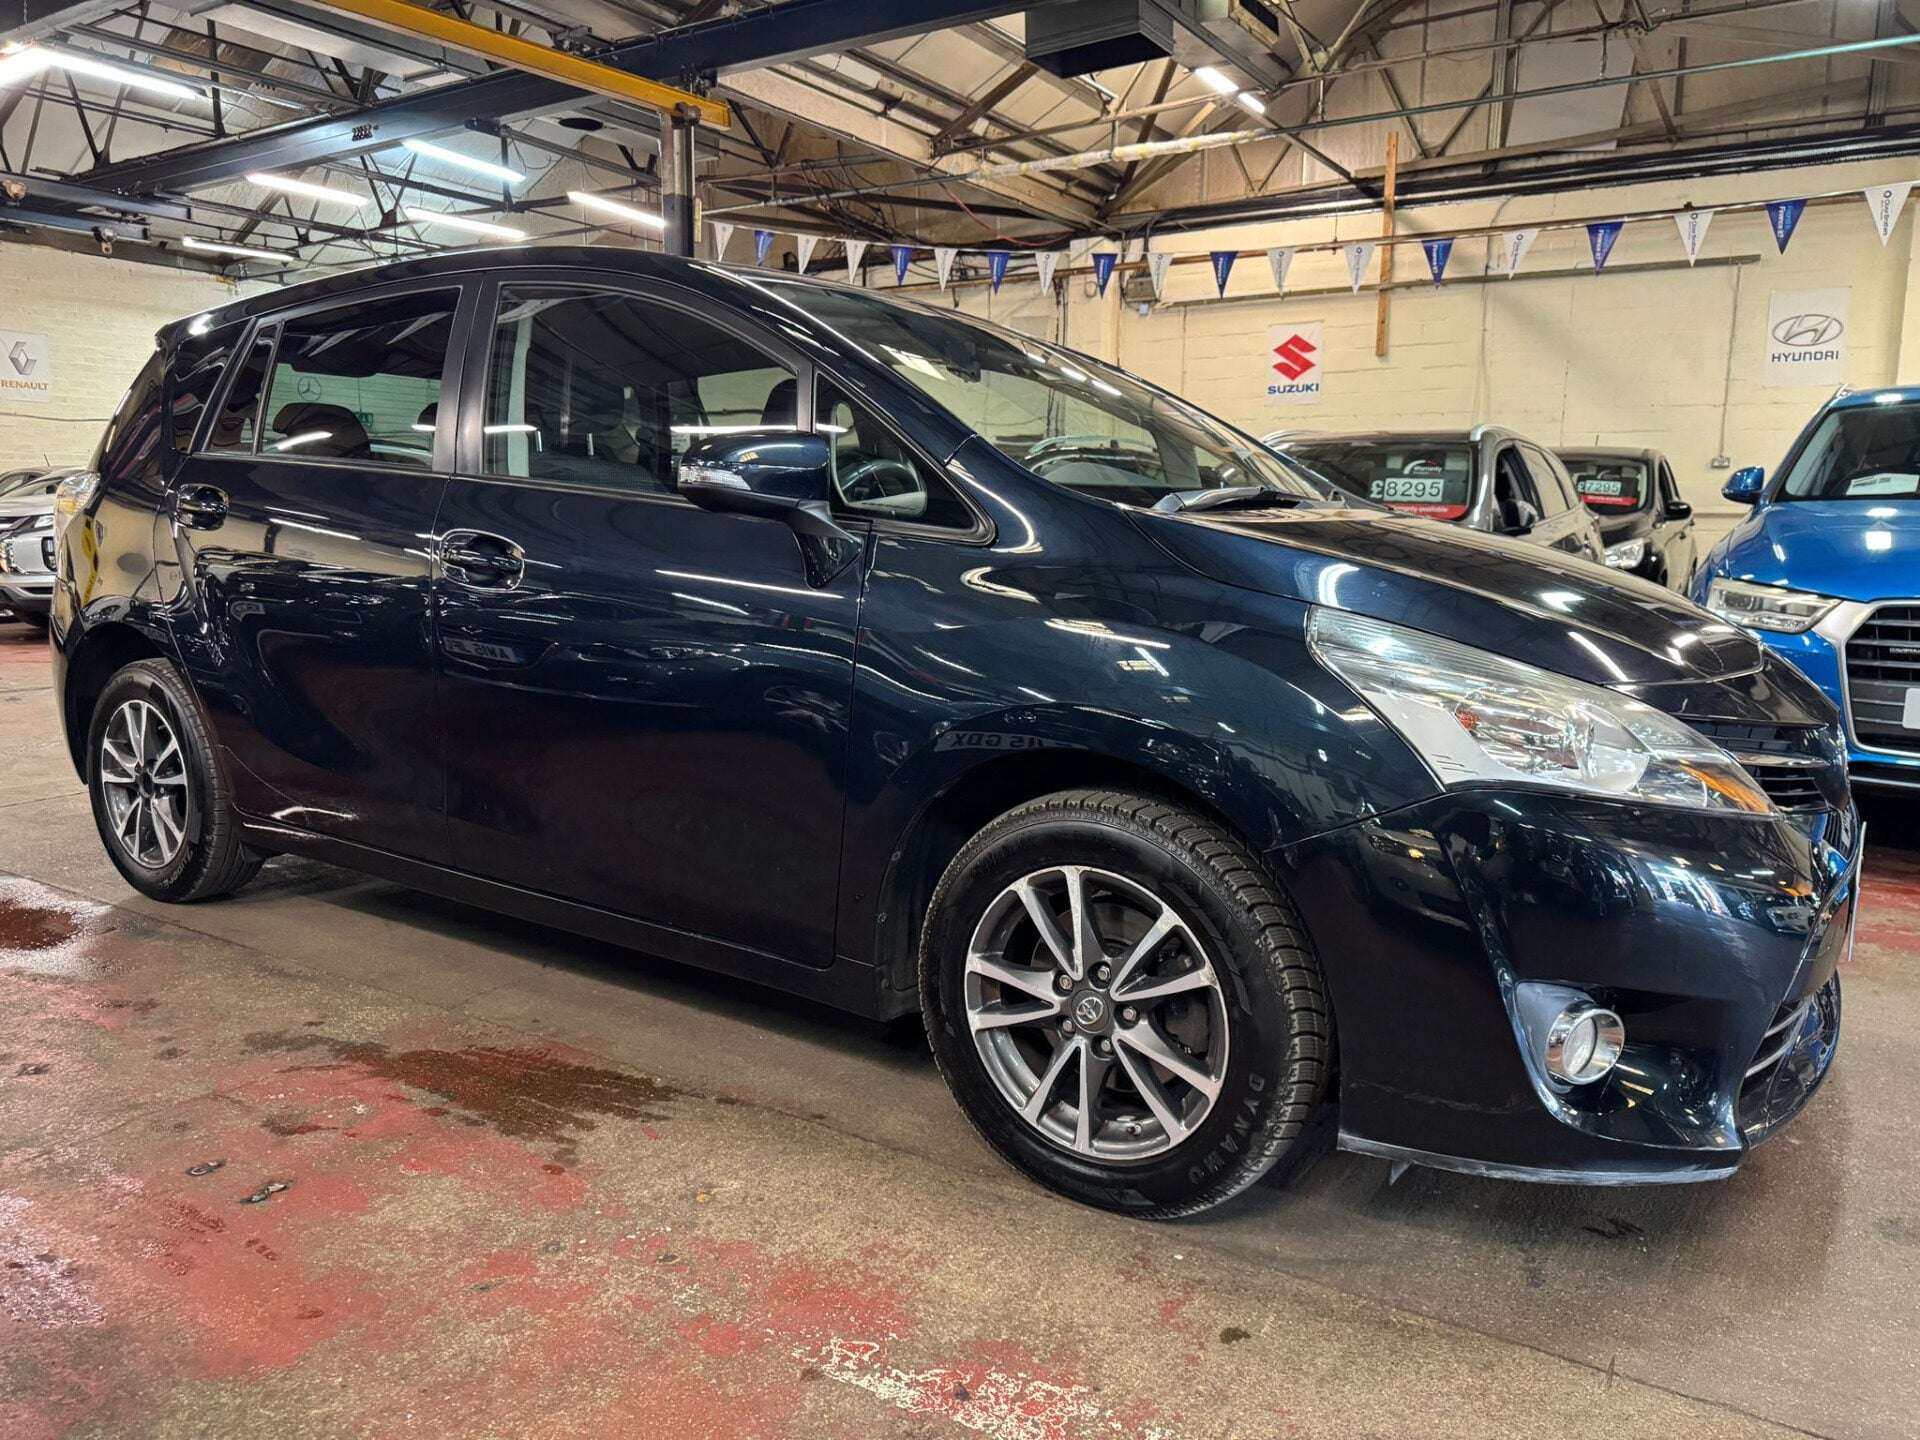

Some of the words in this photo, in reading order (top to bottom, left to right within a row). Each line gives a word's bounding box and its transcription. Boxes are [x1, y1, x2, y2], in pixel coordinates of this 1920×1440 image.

[1771, 350, 1839, 363] HYUNDAI
[0, 379, 48, 391] RENAULT
[1267, 383, 1319, 395] SUZUKI
[1370, 480, 1441, 499] £8295
